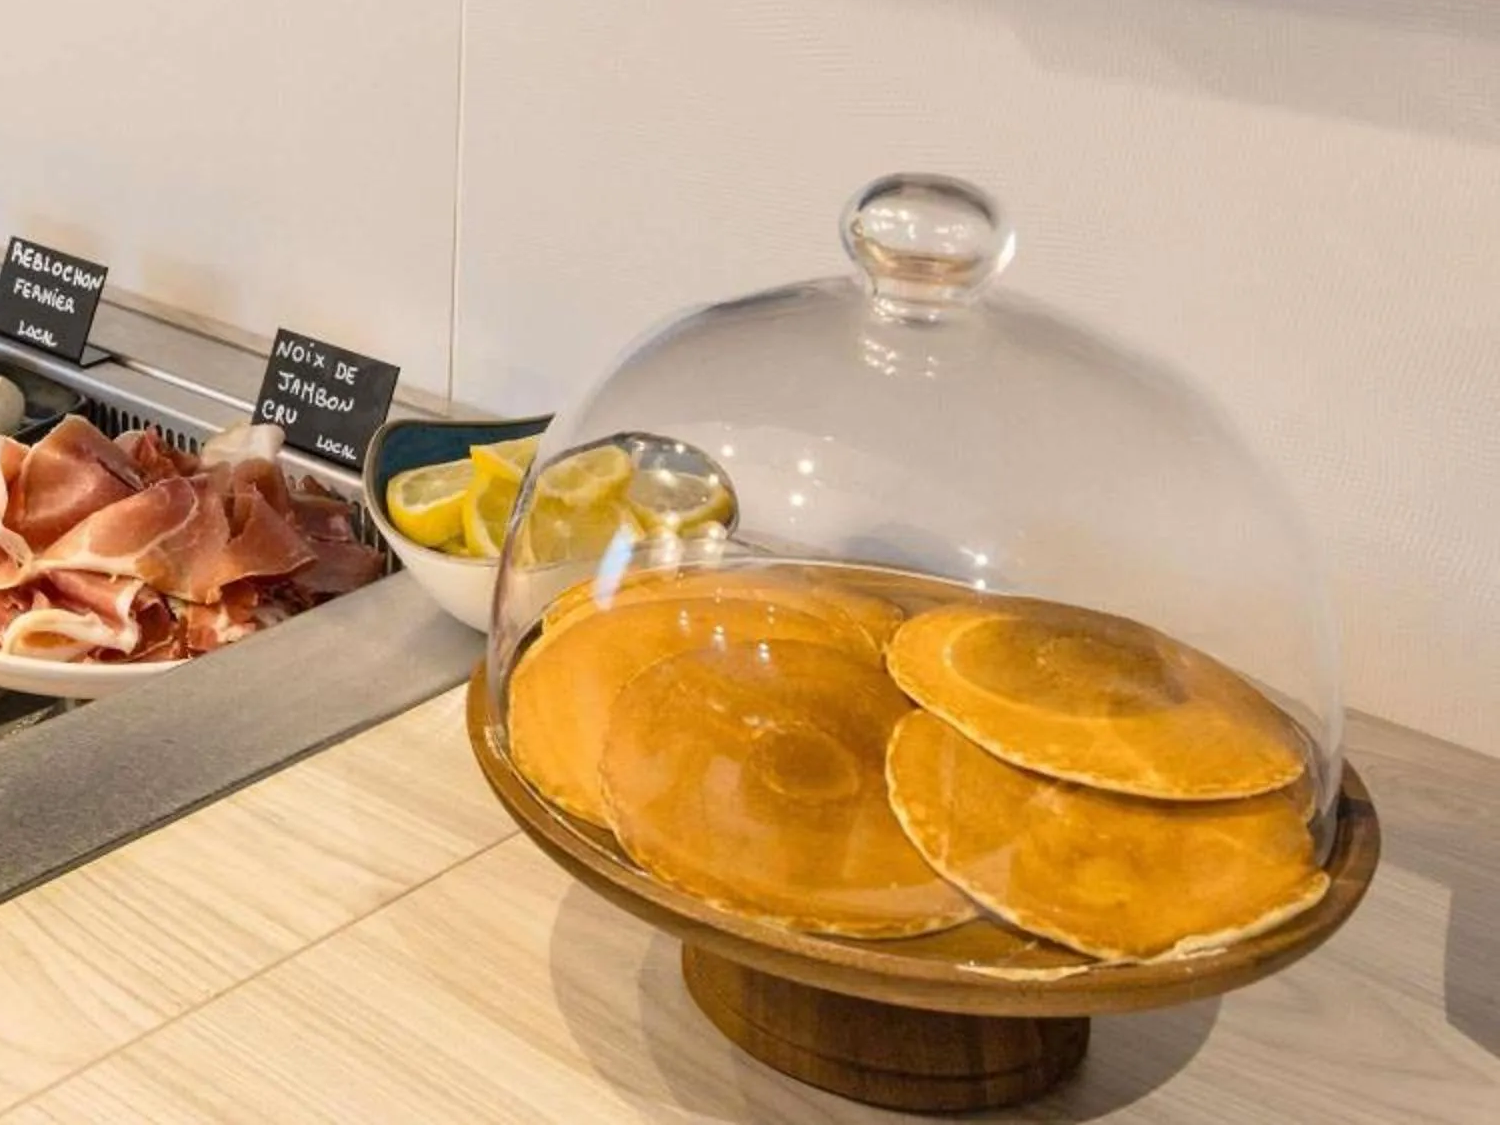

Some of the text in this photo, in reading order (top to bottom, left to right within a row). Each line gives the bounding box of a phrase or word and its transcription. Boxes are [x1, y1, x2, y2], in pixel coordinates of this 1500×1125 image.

[11, 241, 105, 291] REBLOCHON
[17, 319, 58, 347] LOCAL
[334, 362, 359, 385] DE
[277, 370, 355, 412] JAMBON
[261, 399, 298, 425] CRU
[316, 434, 357, 461] LOCAL
